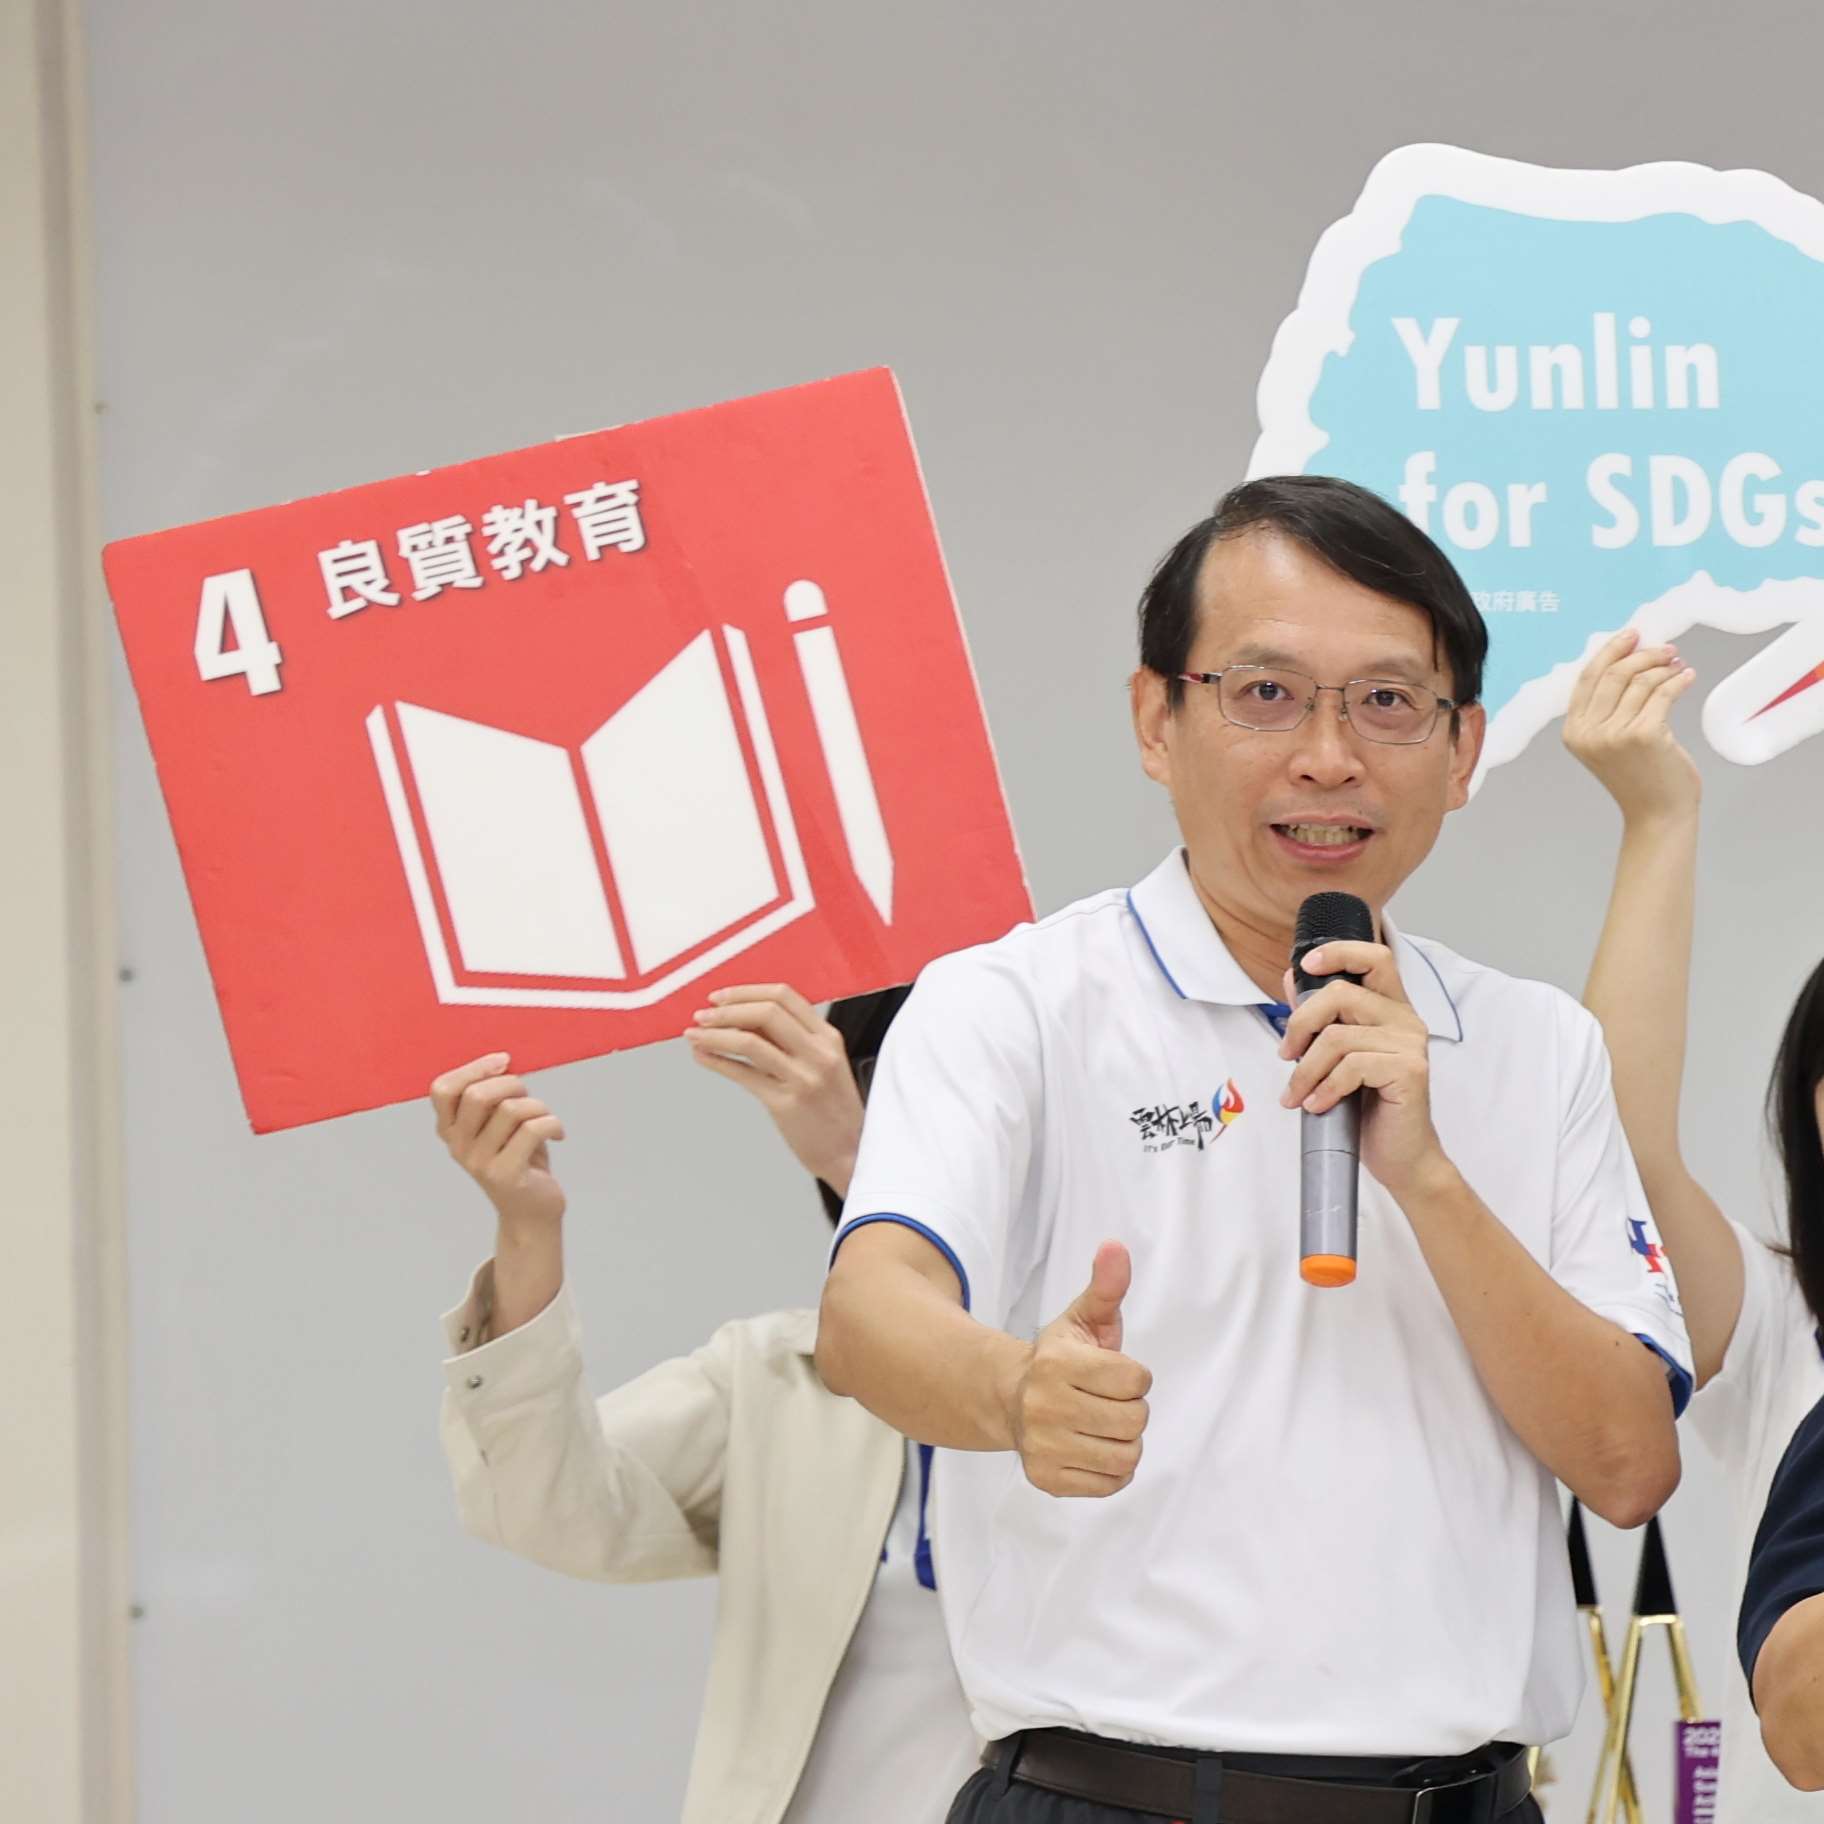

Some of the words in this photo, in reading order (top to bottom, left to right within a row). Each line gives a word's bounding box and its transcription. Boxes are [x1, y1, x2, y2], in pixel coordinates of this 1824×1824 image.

[1391, 311, 1721, 411] Yunlin
[1398, 450, 1548, 551] for
[194, 568, 282, 696] 4
[318, 478, 646, 619] 良質教育
